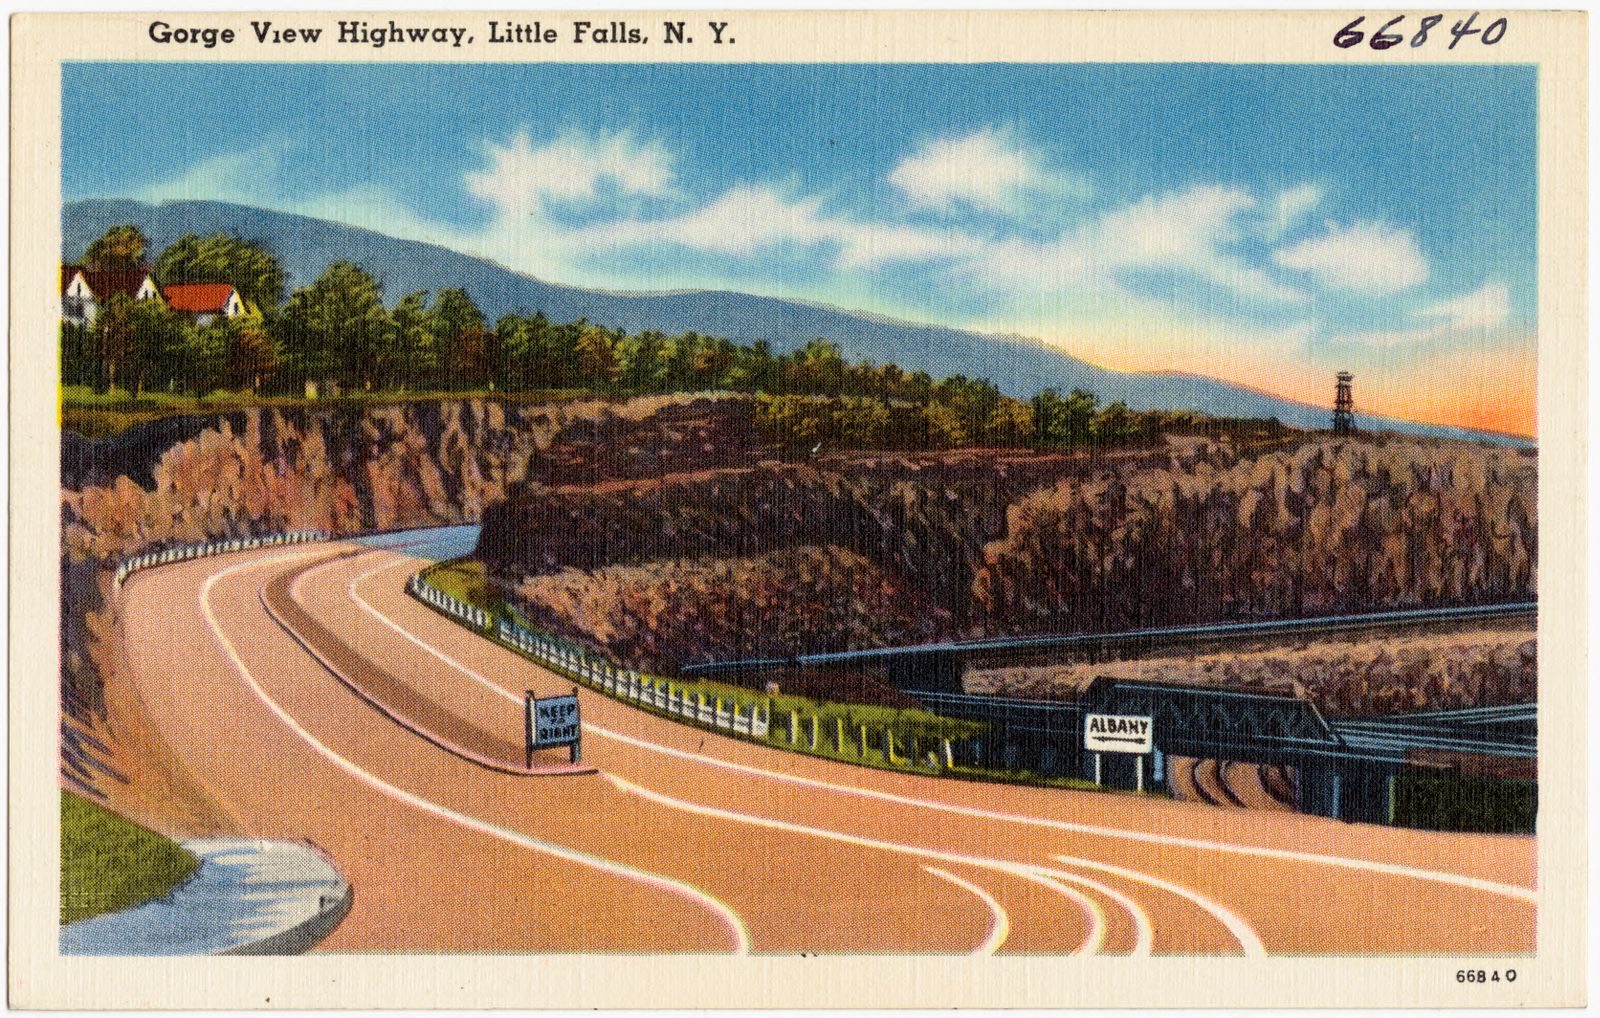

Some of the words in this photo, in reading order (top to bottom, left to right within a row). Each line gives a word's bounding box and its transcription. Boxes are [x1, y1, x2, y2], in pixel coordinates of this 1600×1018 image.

[148, 21, 235, 49] Gorge
[250, 21, 323, 44] View
[337, 20, 474, 48] Highway,
[488, 21, 558, 44] Little
[573, 21, 649, 45] Falls,
[663, 21, 693, 44] N.
[708, 21, 736, 44] Y.
[1333, 11, 1508, 50] 66840
[540, 703, 576, 719] KEEP
[1089, 717, 1148, 735] ALBANY
